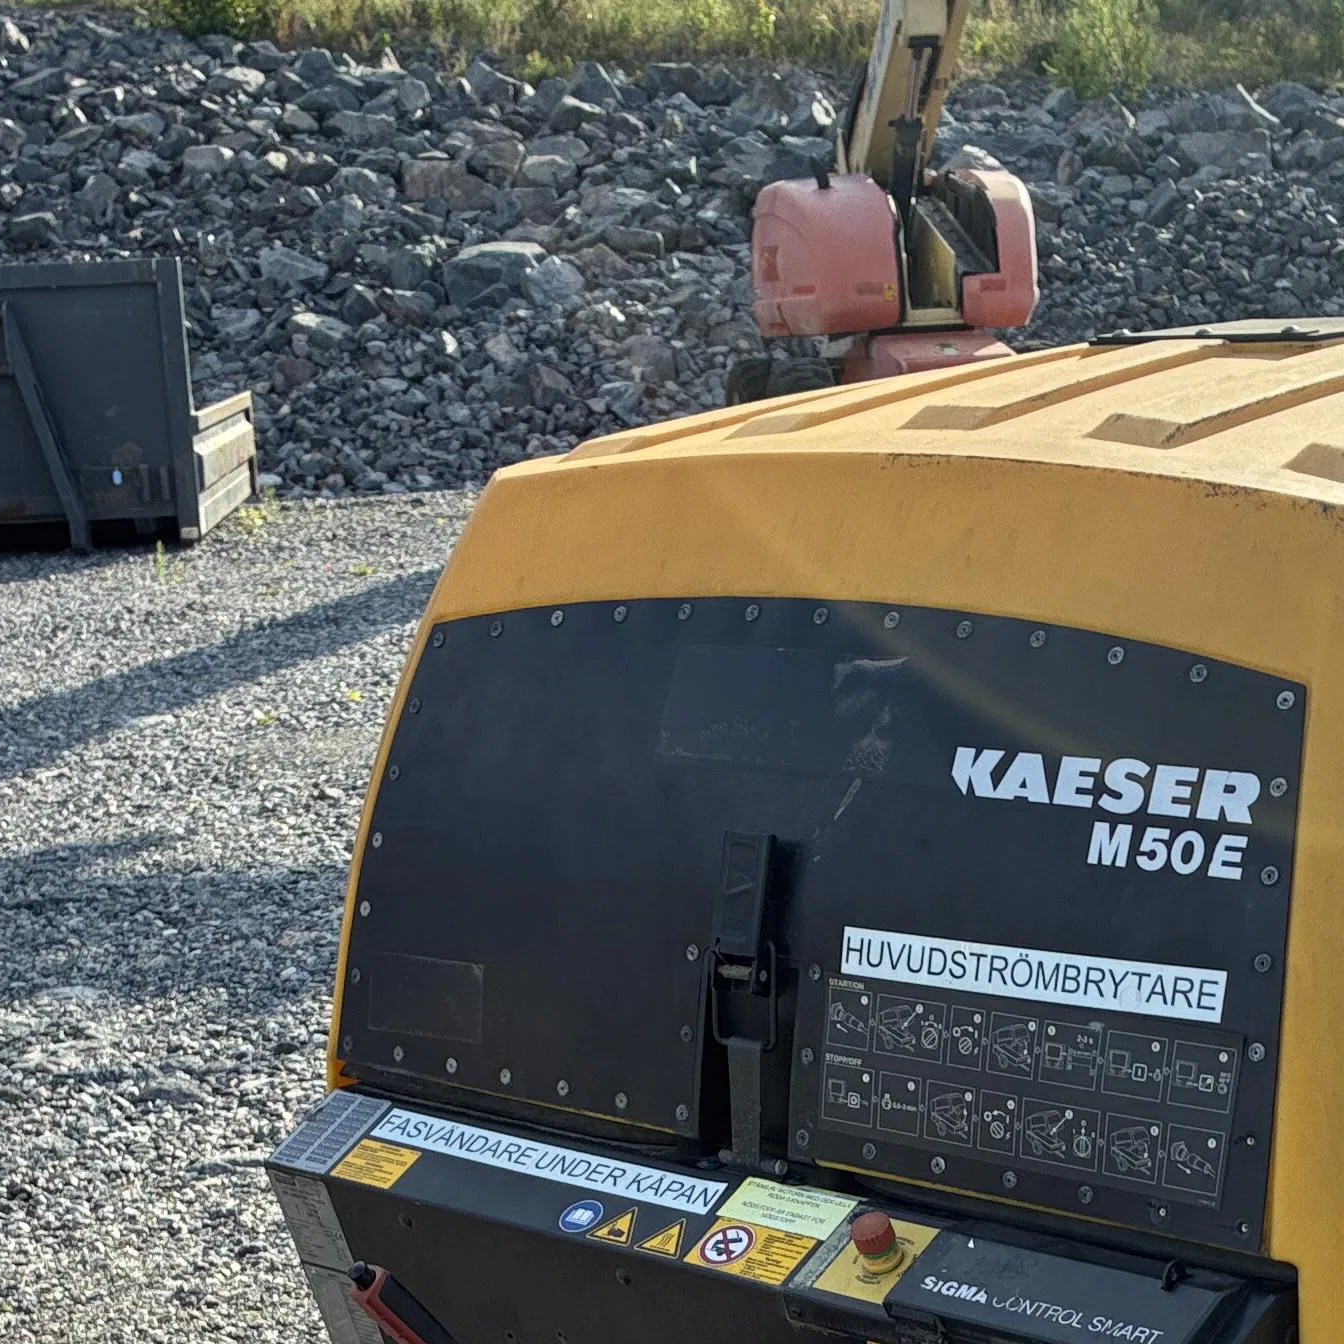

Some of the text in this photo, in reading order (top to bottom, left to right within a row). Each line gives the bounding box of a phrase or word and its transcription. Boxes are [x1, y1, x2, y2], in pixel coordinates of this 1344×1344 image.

[951, 746, 1261, 825] KAESER
[845, 935, 1220, 1011] HUVUDSTRÖMBRYTARE
[379, 1114, 535, 1166] FASVÄNDARE
[534, 1151, 627, 1187] UNDER
[625, 1172, 719, 1208] KÅPAN
[920, 1275, 988, 1305] SIGMA
